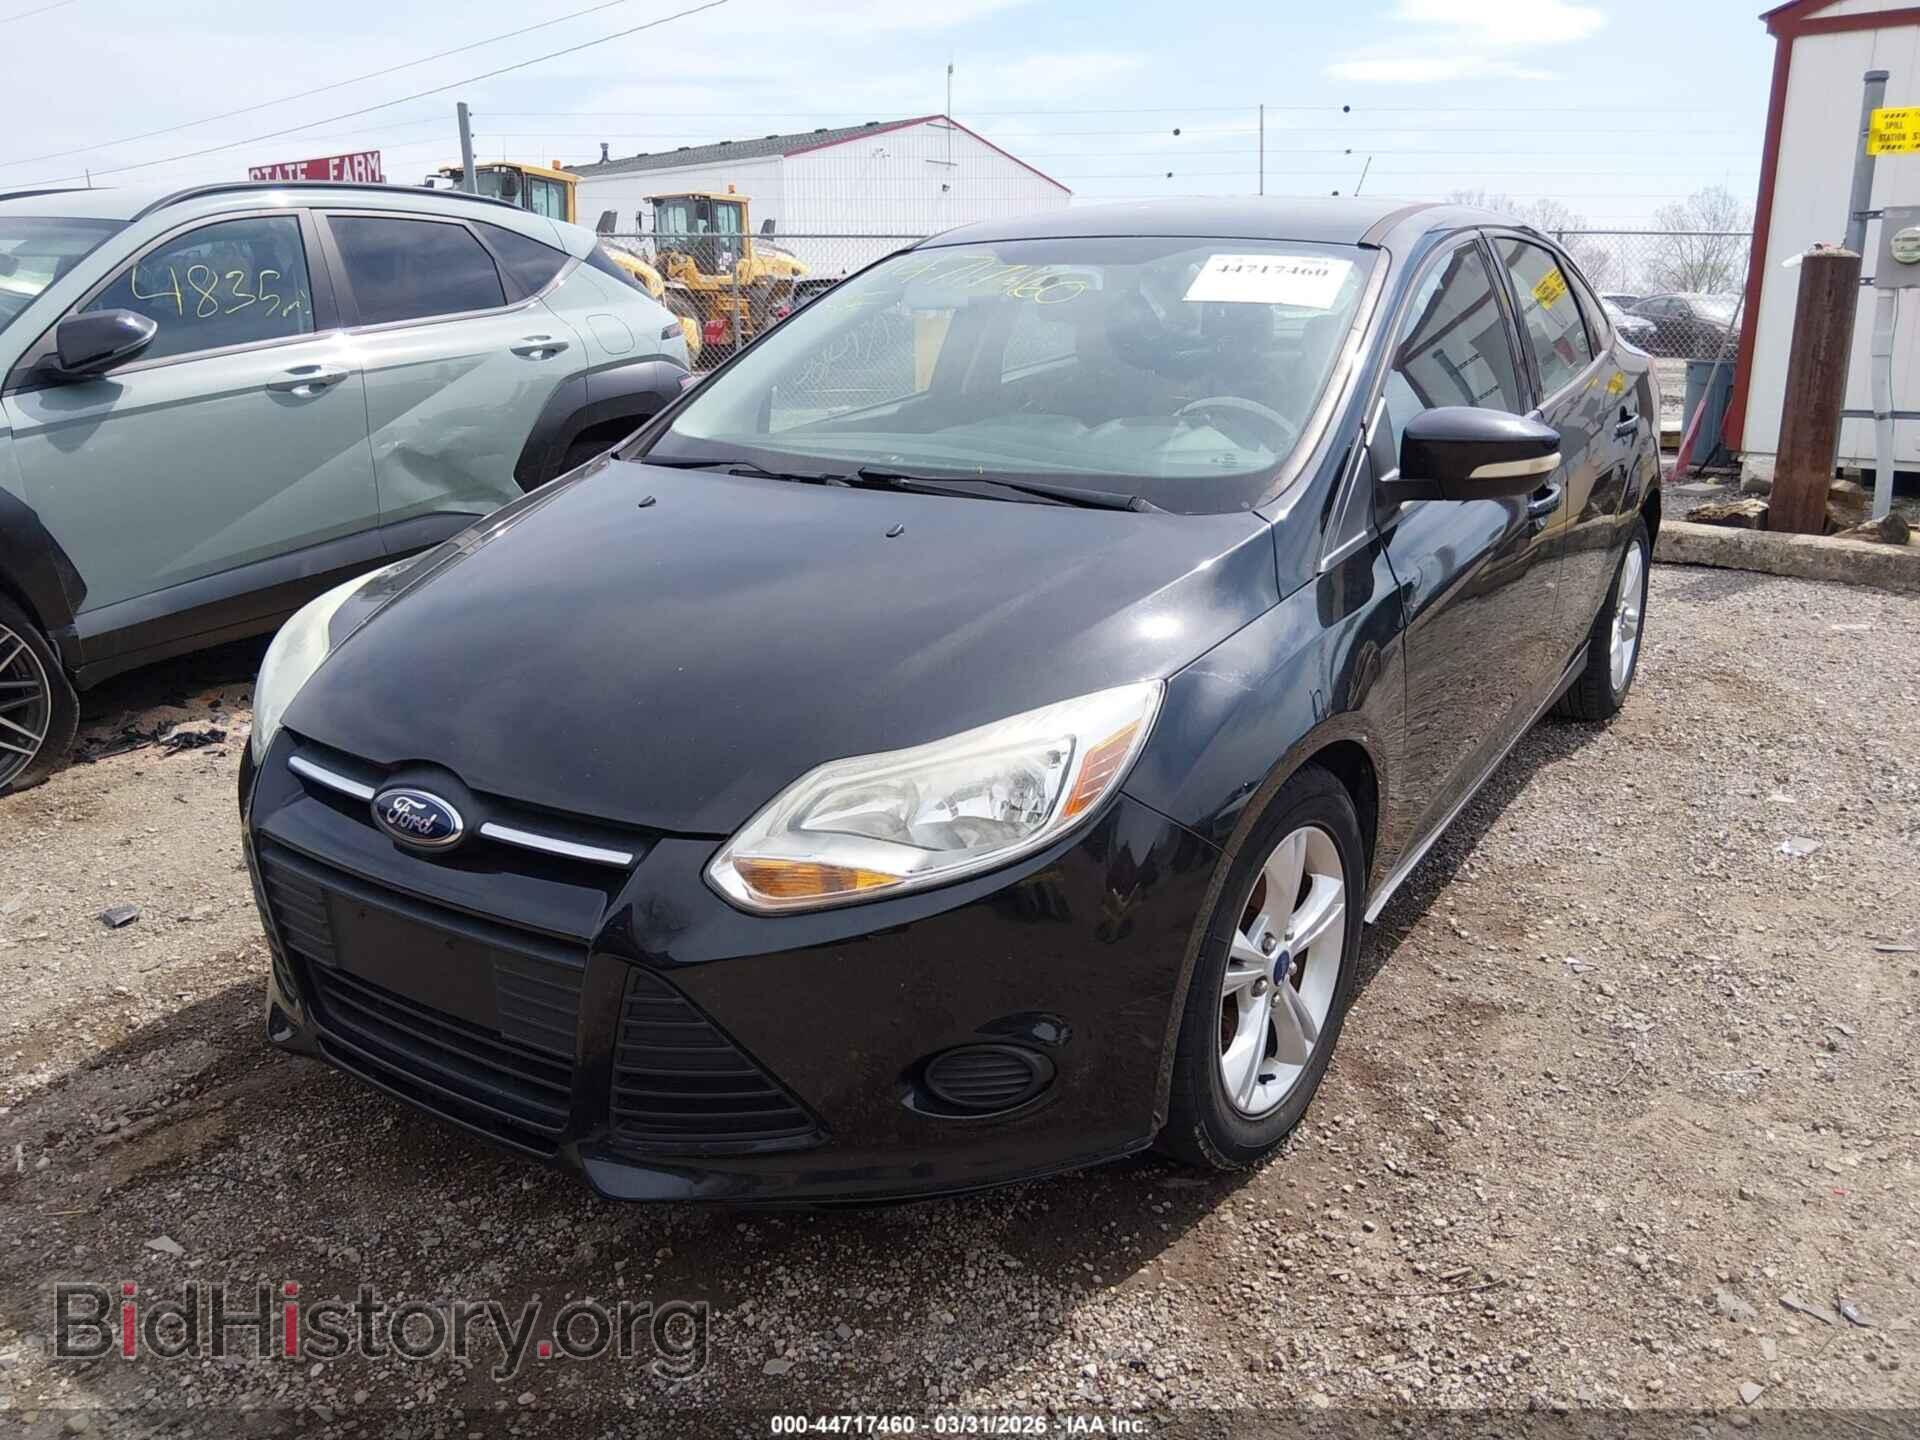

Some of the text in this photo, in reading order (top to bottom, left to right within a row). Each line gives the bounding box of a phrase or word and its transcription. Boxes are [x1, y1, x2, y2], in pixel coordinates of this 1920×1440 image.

[1879, 132, 1906, 142] STATION
[249, 153, 380, 182] STATE FARM
[131, 264, 281, 318] 4835
[386, 796, 438, 834] Ford
